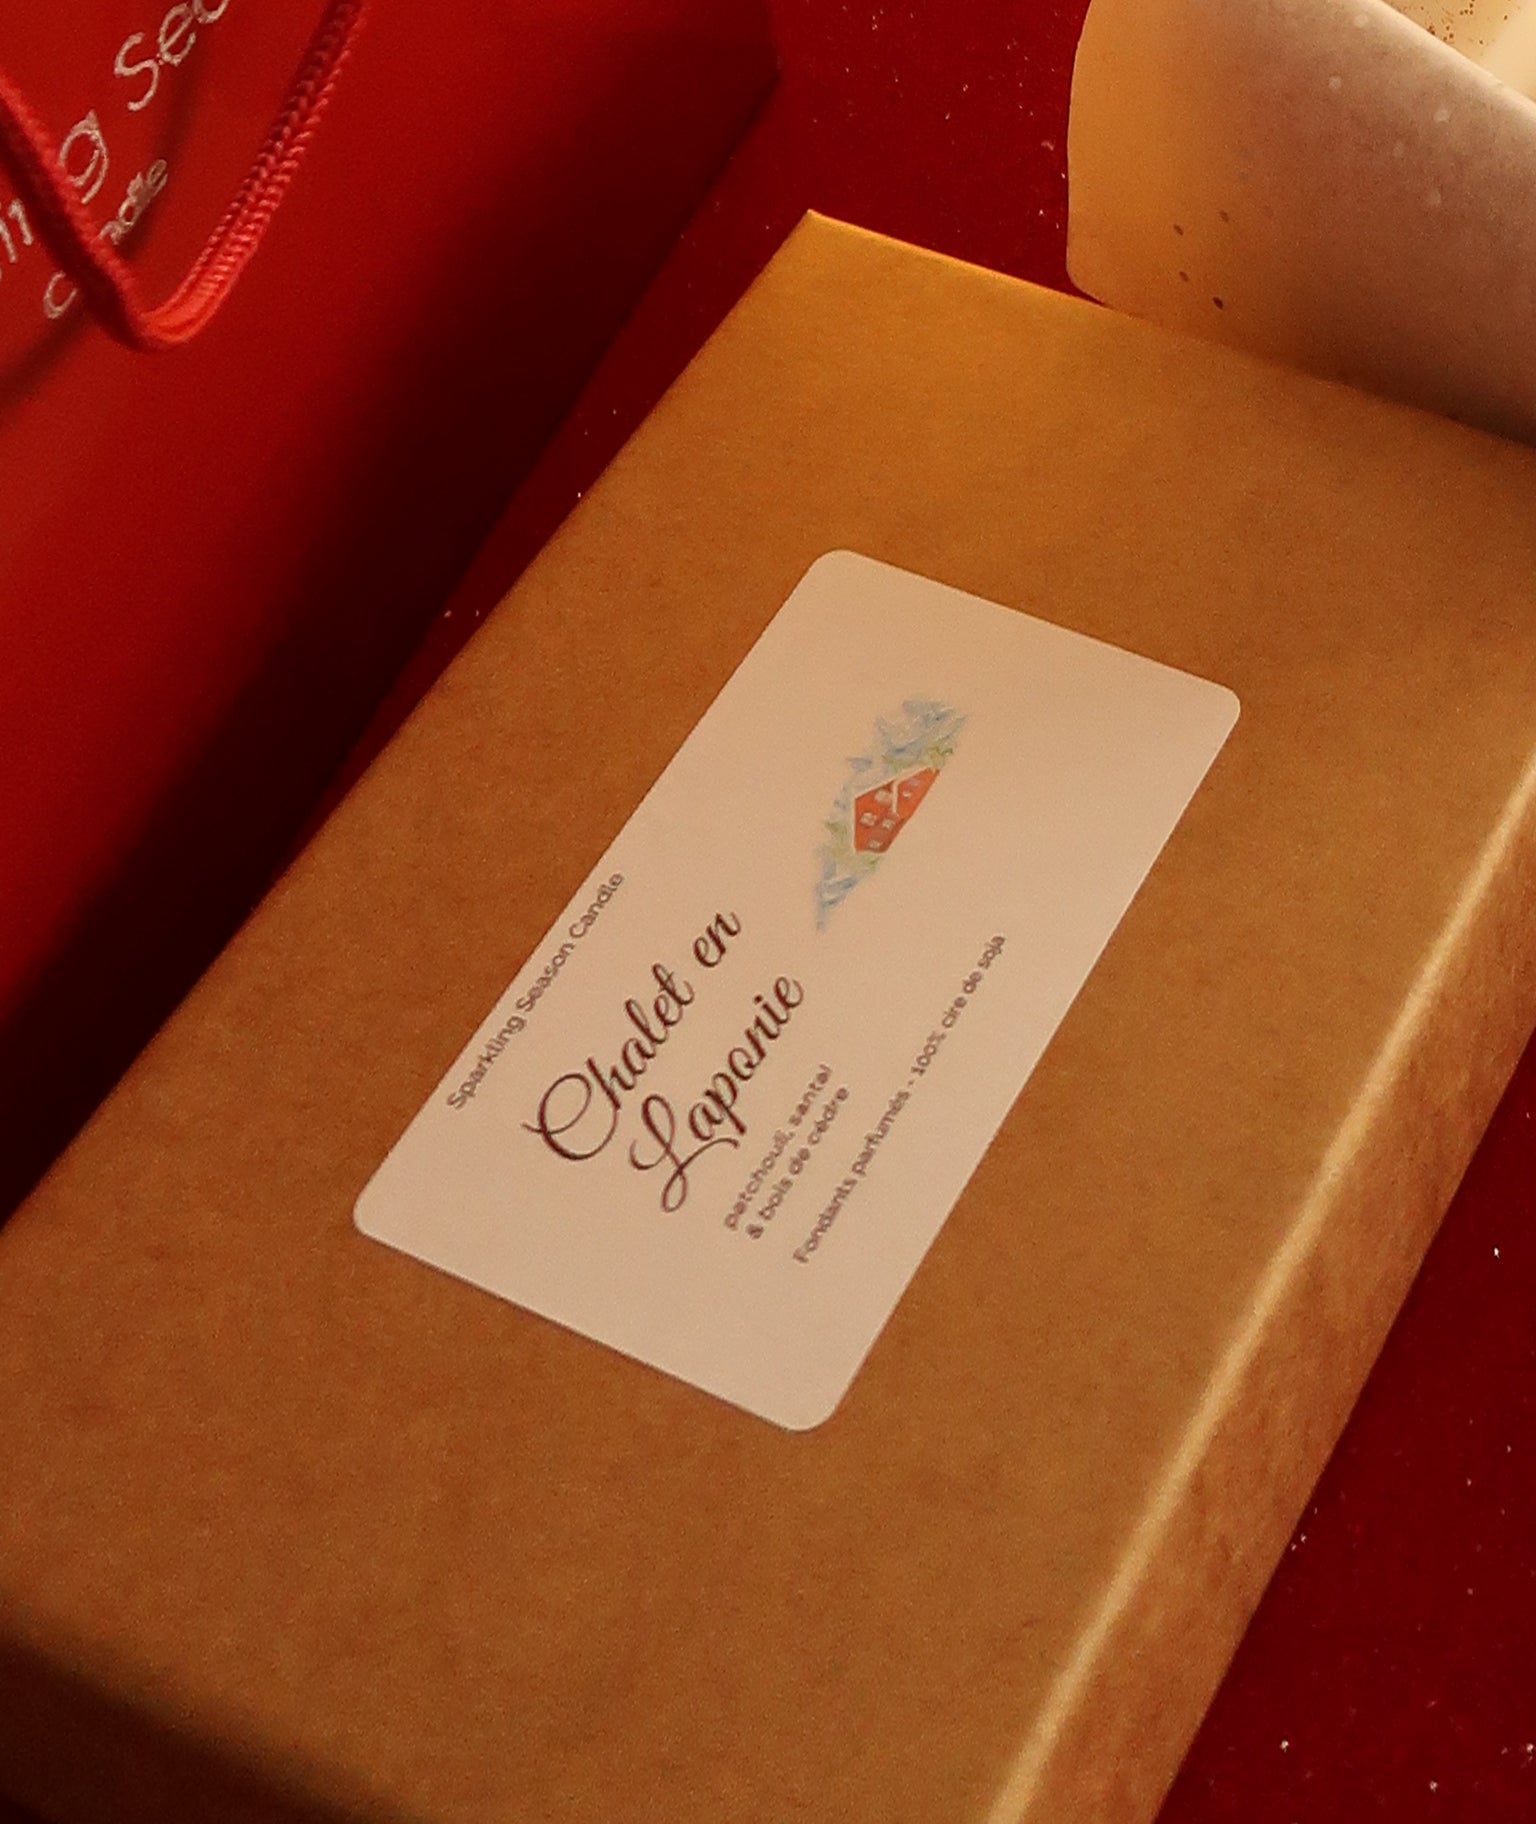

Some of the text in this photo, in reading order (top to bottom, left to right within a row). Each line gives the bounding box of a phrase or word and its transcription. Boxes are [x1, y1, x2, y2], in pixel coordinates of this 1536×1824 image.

[447, 873, 624, 1110] Sparkling Season Candle
[520, 912, 742, 1161] Chalet en
[629, 976, 804, 1213] Laponie
[789, 1063, 832, 1127] santal
[792, 1178, 857, 1264] Fondants
[852, 1090, 910, 1177] parfumés
[911, 1030, 946, 1077] 100%
[942, 996, 968, 1028] cire
[962, 970, 983, 995] de
[977, 935, 1005, 970] soja
[746, 1223, 764, 1240] &
[758, 1177, 793, 1221] bois
[789, 1148, 810, 1175] de
